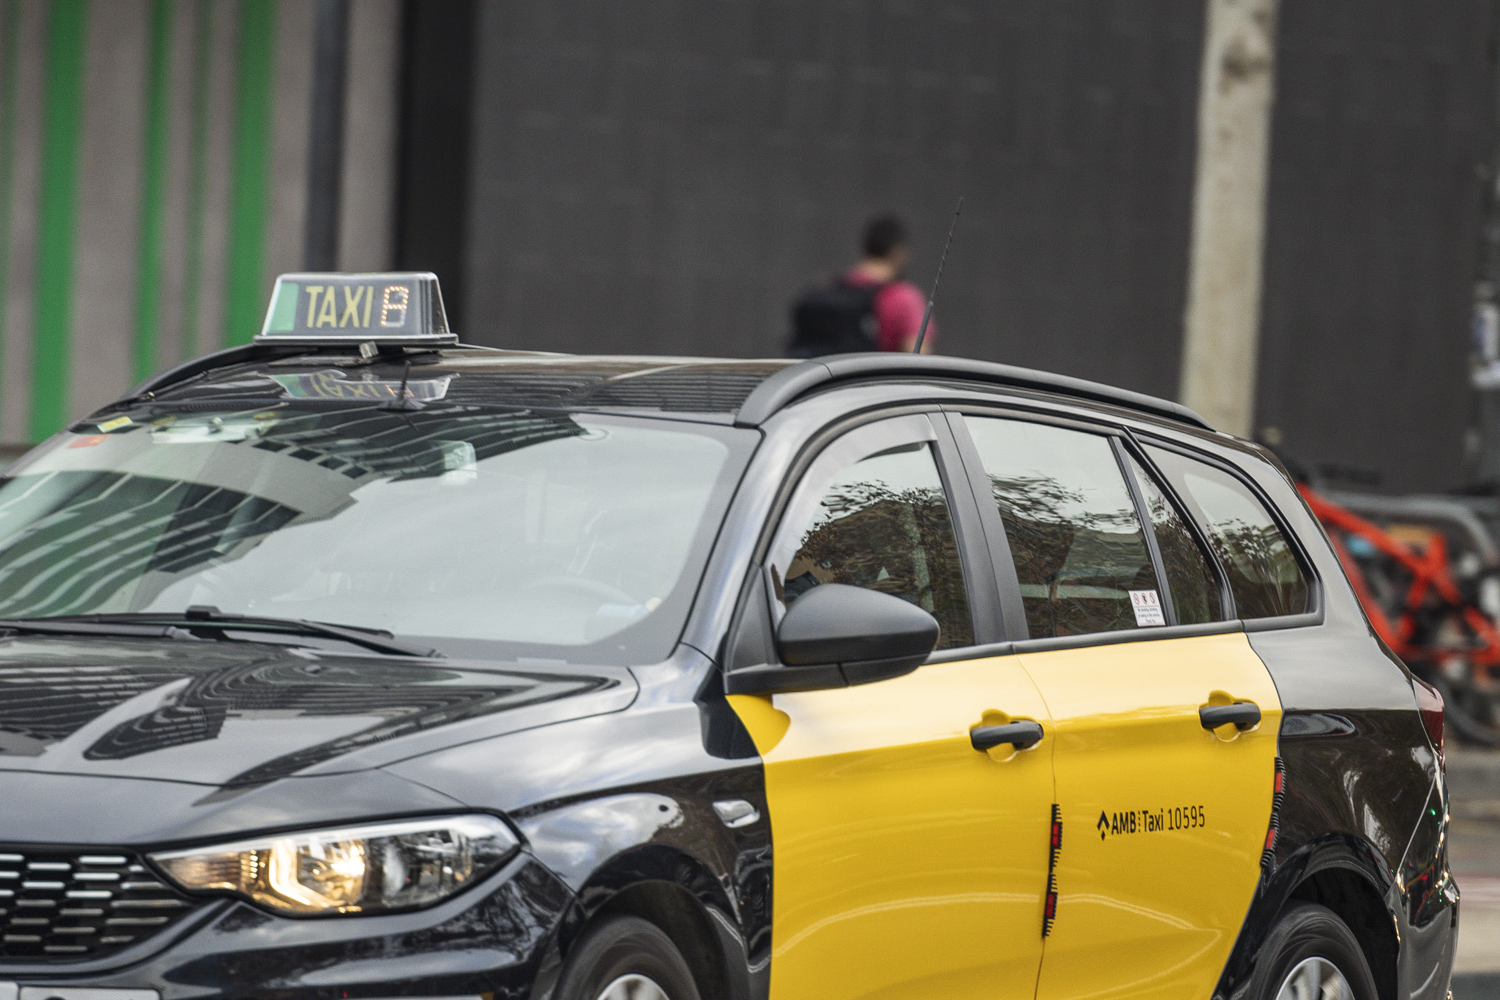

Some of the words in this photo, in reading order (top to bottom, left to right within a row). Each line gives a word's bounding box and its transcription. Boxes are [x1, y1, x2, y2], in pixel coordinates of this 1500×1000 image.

[305, 285, 374, 328] TAXI
[1111, 811, 1137, 835] AMB
[1142, 808, 1164, 832] Taxi
[1167, 805, 1205, 830] 10595
